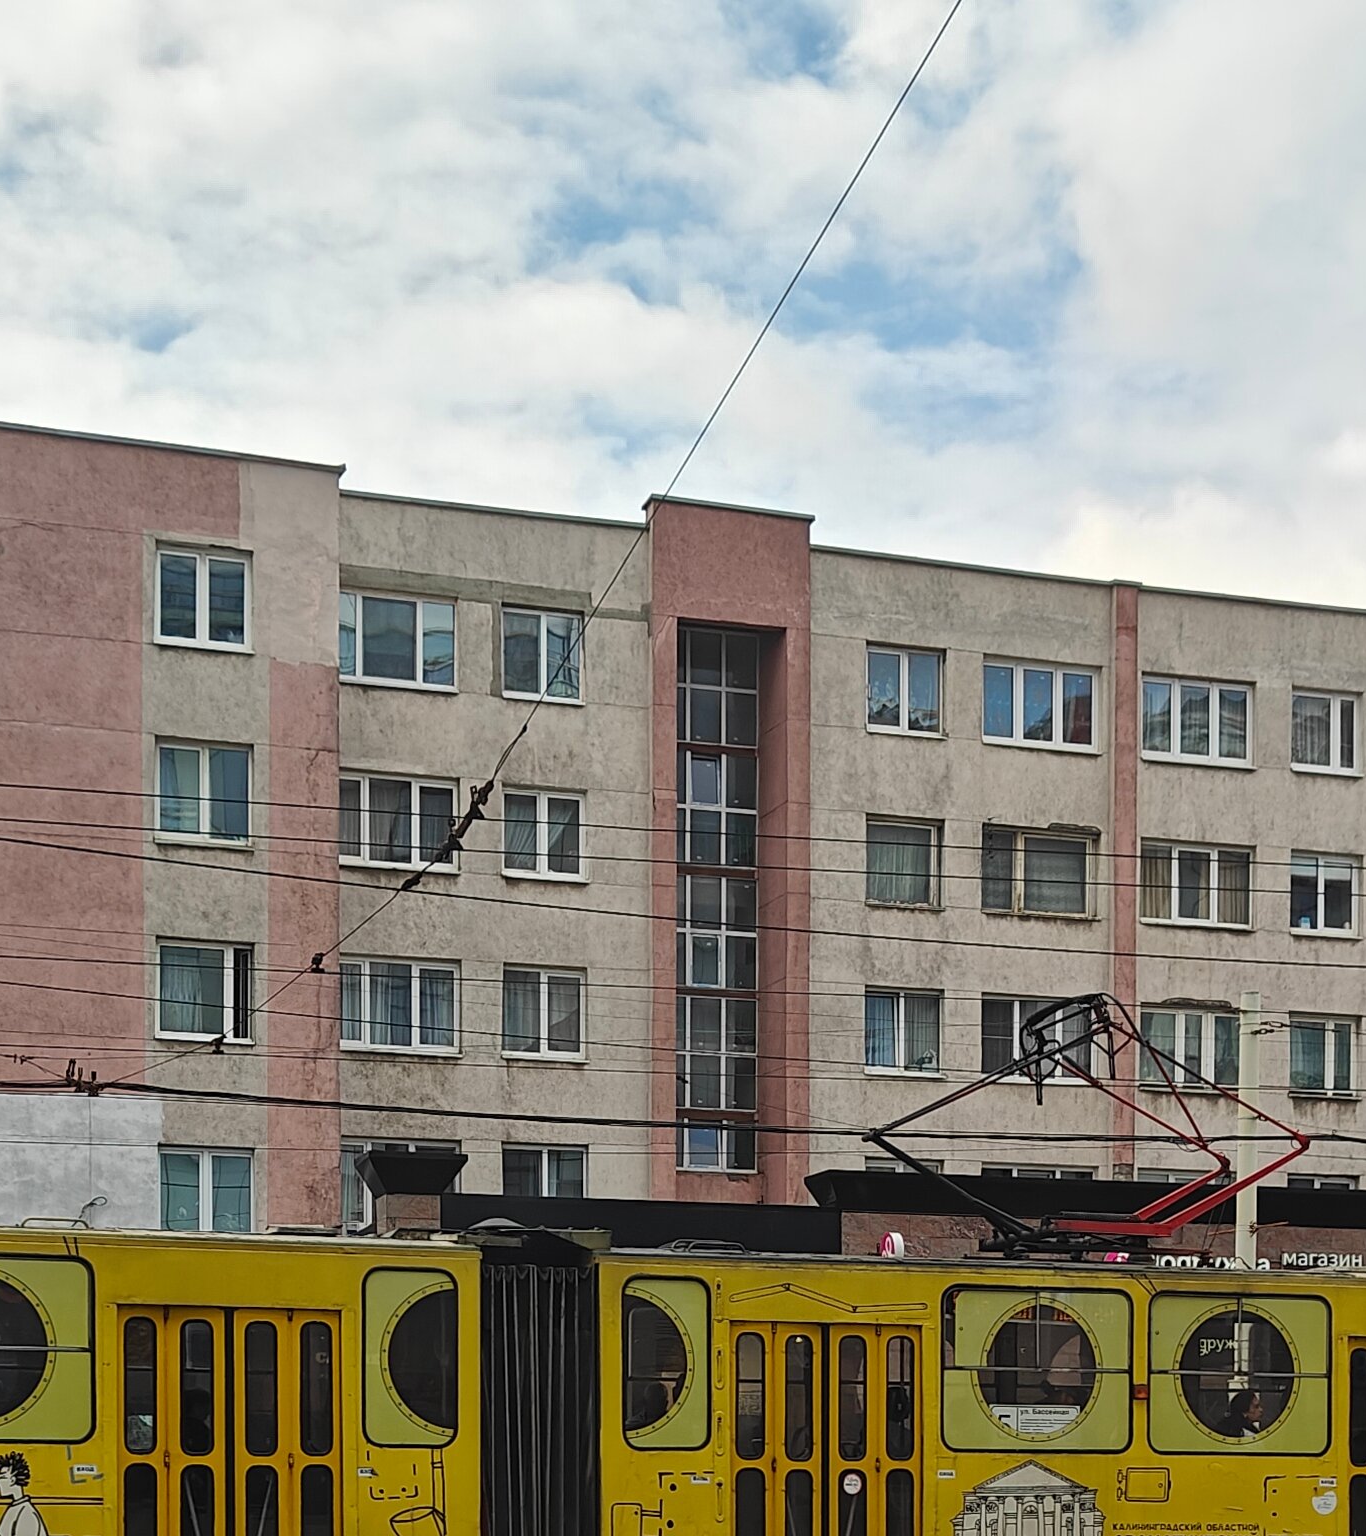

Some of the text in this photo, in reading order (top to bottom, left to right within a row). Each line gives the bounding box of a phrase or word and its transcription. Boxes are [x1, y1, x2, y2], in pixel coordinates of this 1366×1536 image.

[1282, 1252, 1363, 1268] магазин
[1112, 1522, 1260, 1532] КАЛИНИНГРАДСКИЙ ОБЛАСТНОЙ
